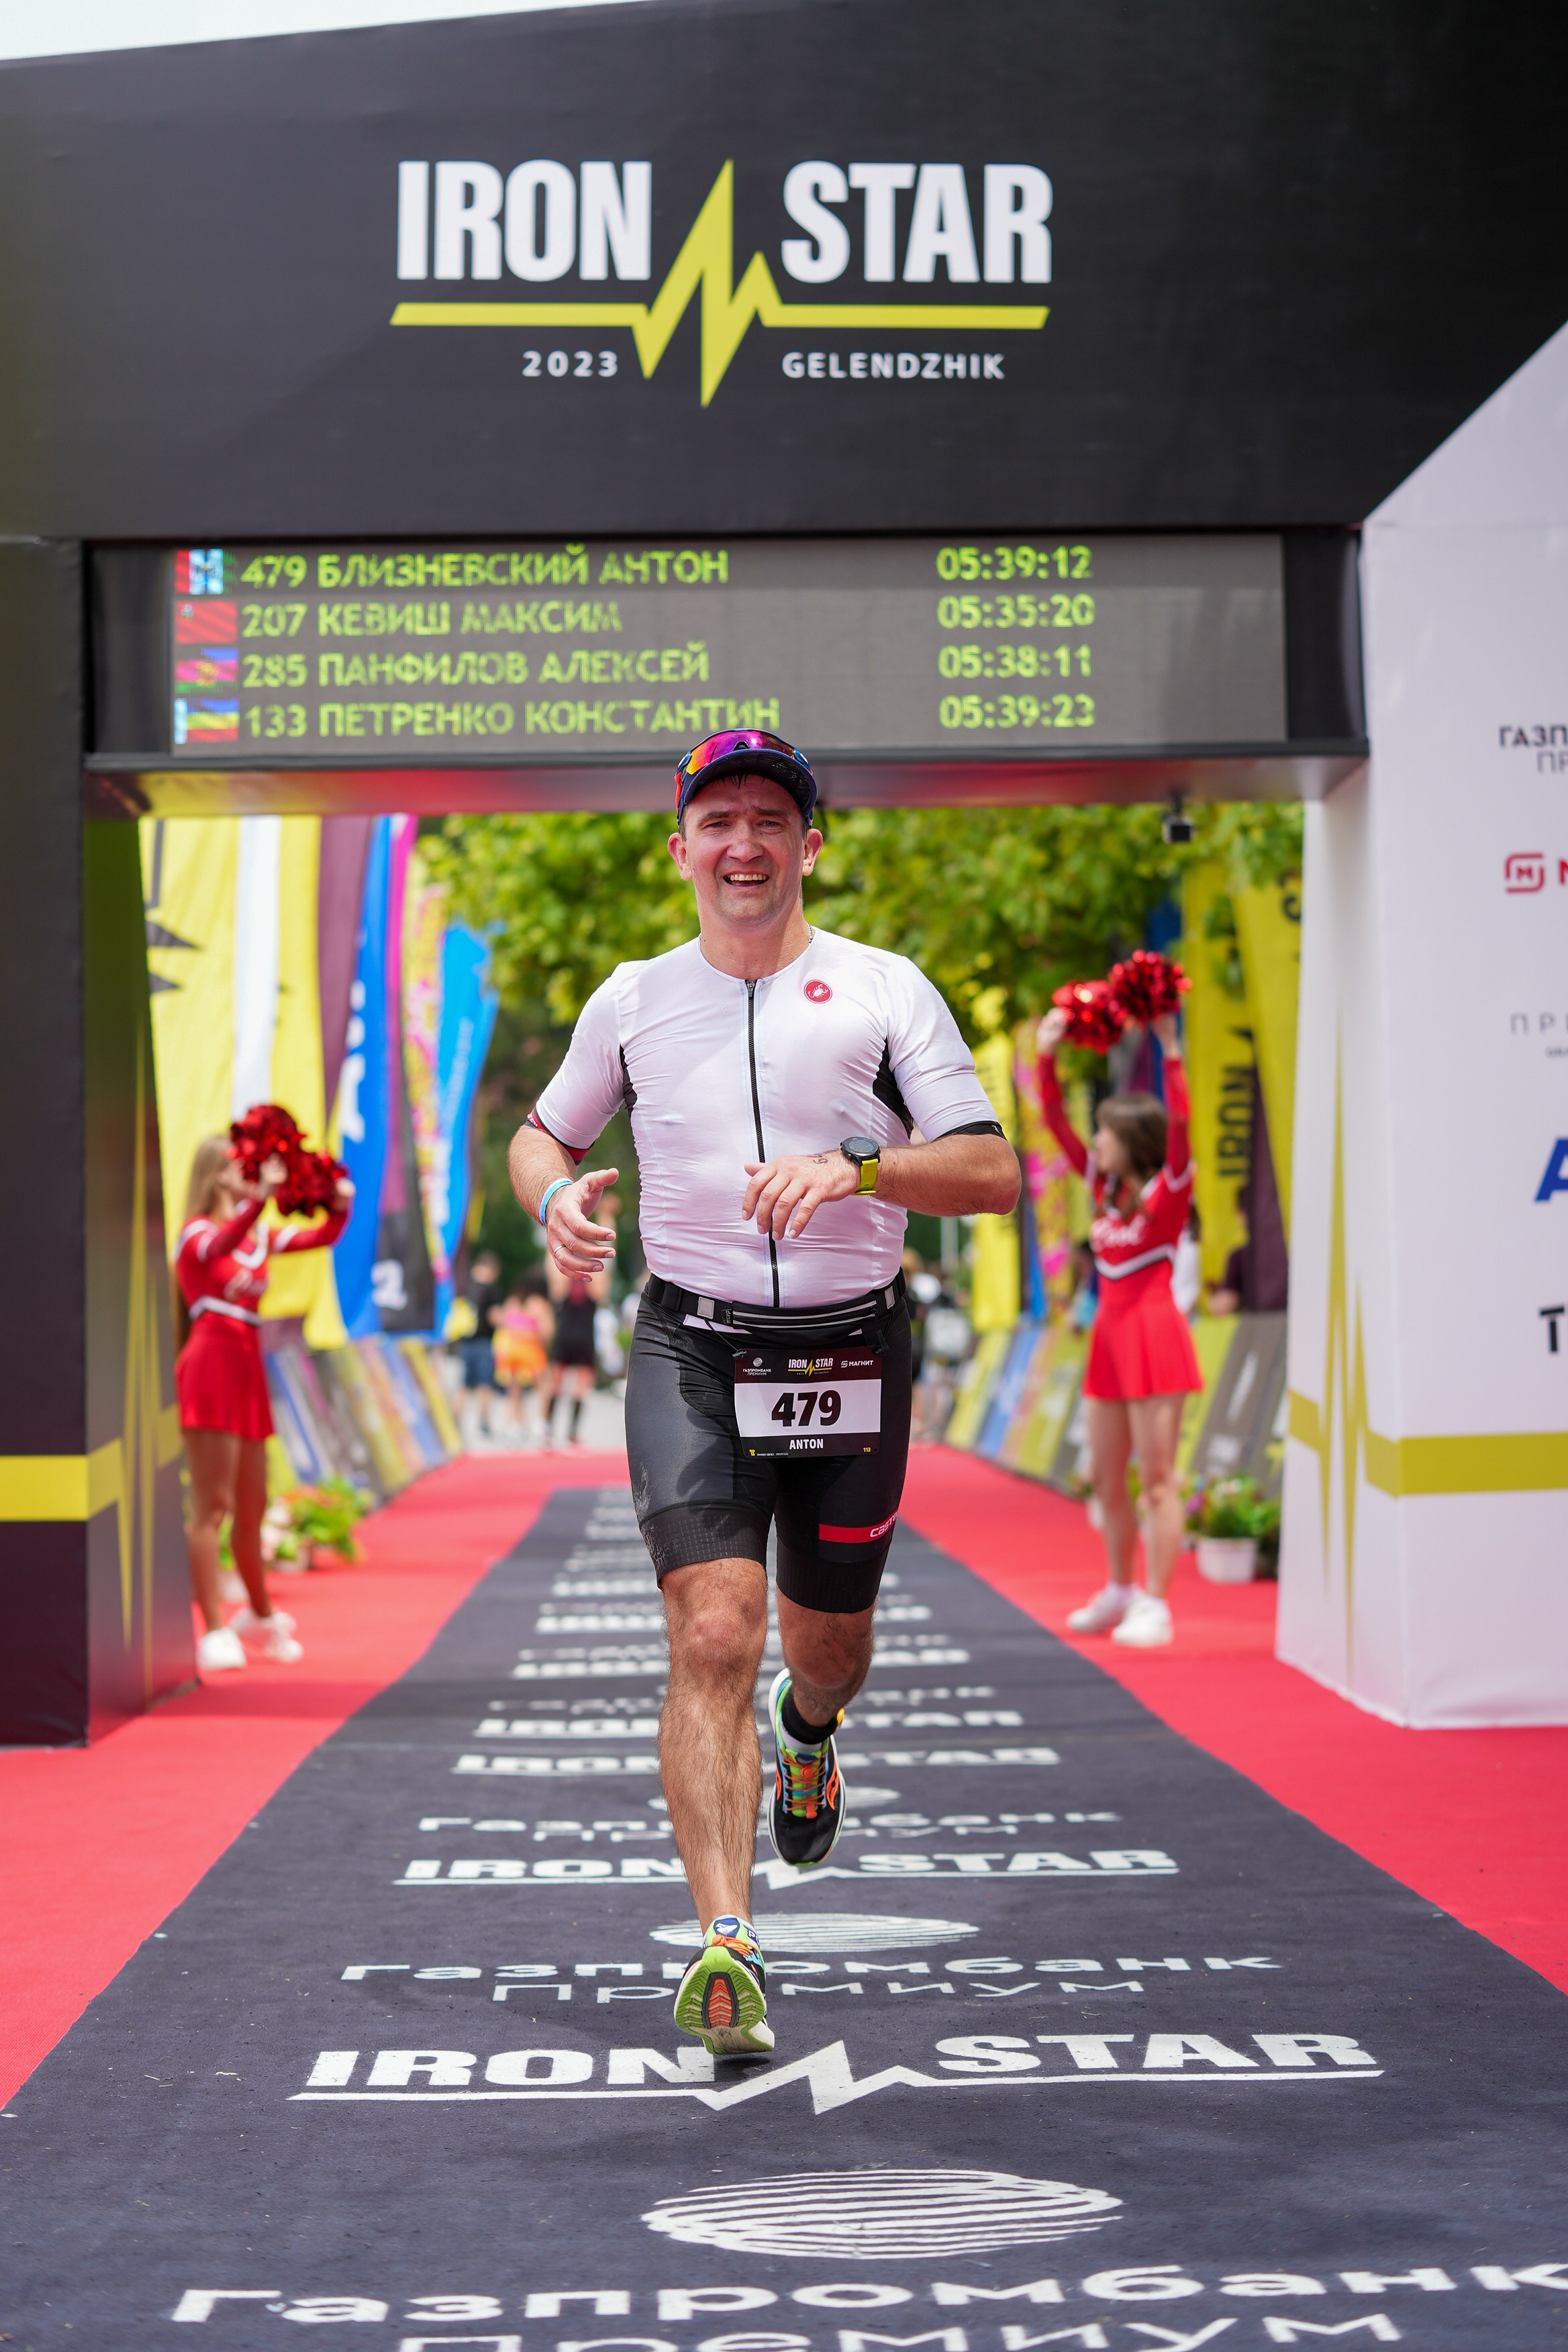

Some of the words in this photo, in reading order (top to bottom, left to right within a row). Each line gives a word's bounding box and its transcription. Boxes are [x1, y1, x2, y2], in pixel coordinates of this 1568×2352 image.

[397, 160, 652, 281] IRON
[781, 160, 1053, 283] STAR
[522, 350, 618, 377] 2023
[781, 351, 1006, 379] GELENDZHIK
[240, 554, 307, 588] 479
[317, 542, 589, 588] БЛИЗНЕВСКИЙ
[599, 549, 729, 585] АНТОН
[936, 545, 1093, 580] 05:39:12
[242, 603, 307, 637] 207
[318, 601, 451, 636] КЕВИШ
[460, 599, 624, 635] МАКСИМ
[937, 593, 1095, 628] 05:35:20
[242, 653, 308, 688] 285
[319, 650, 529, 687] ПАНФИЛОВ
[538, 640, 710, 684] АЛЕКСЕЙ
[938, 643, 1091, 678] 05:38:11
[244, 703, 308, 738] 133
[319, 701, 516, 737] ПЕТРЕНКО
[525, 696, 780, 734] КОНСТАНТИН
[940, 693, 1095, 729] 05:39:23
[788, 1359, 807, 1369] IRON
[815, 1357, 834, 1368] STAR
[771, 1389, 842, 1428] 479
[789, 1438, 824, 1451] ANTON
[859, 1850, 1178, 1873] STAR
[492, 1981, 1144, 2004] Прмиум
[306, 2048, 715, 2086] IRON
[936, 2034, 1378, 2072] STAR
[171, 2262, 1568, 2324] Газпромбанк
